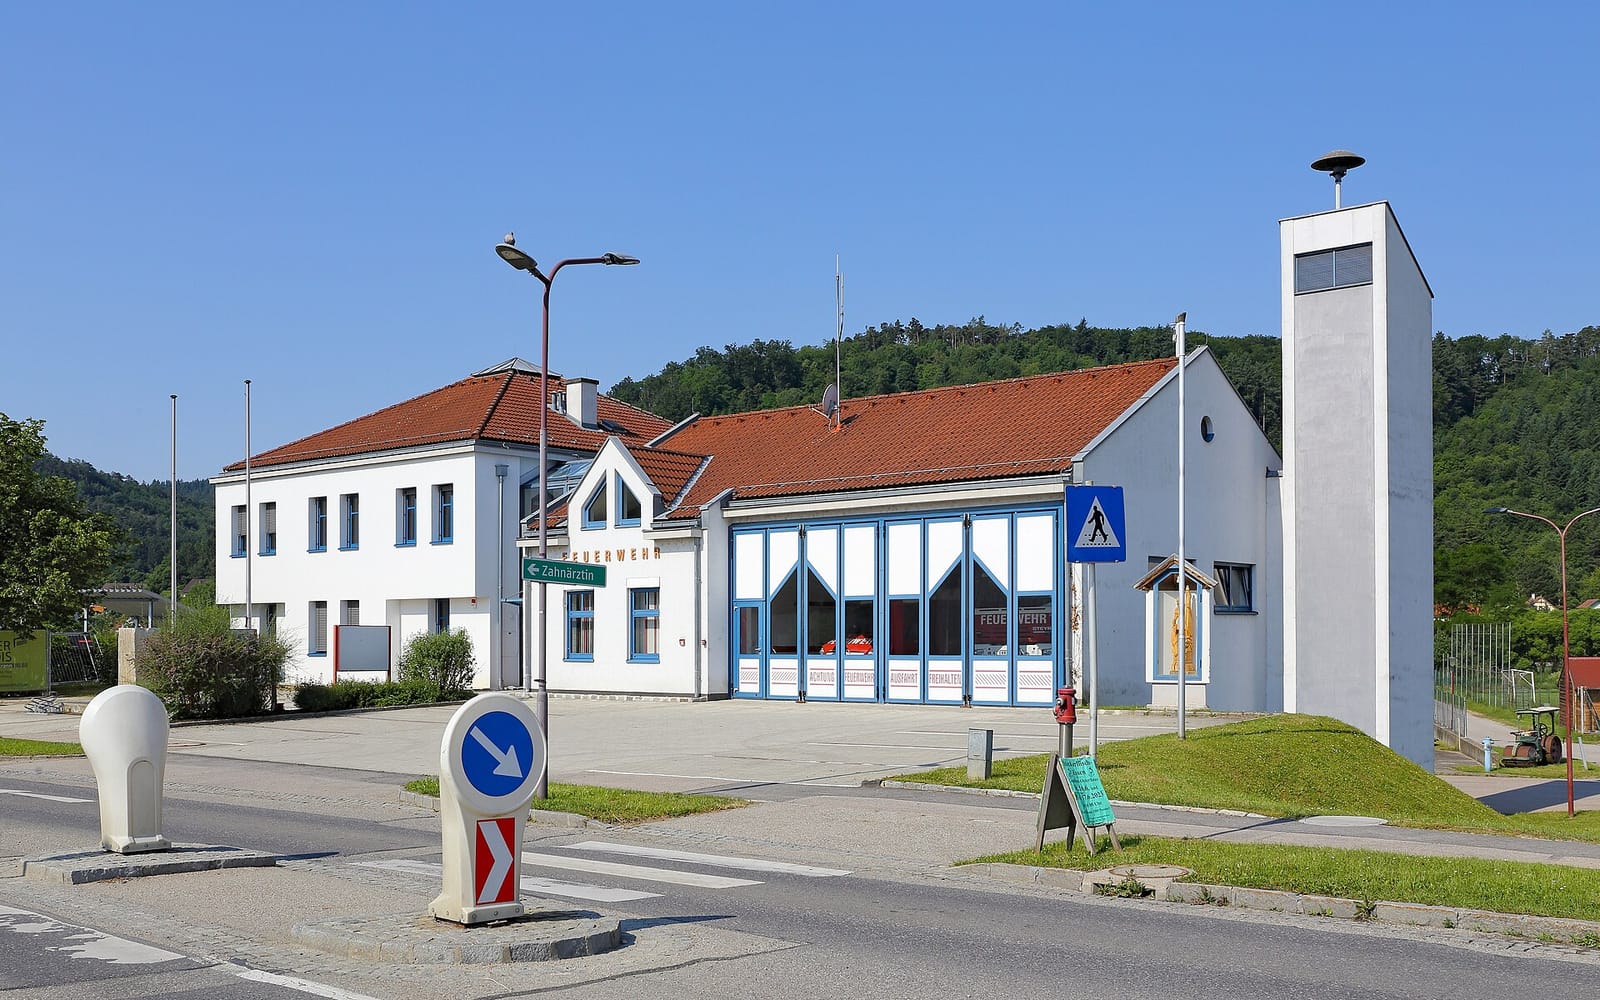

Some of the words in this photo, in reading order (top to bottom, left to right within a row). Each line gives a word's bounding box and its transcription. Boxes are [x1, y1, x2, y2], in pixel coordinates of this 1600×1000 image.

[561, 547, 661, 562] FEUERWEHR
[541, 565, 594, 581] Zahnärztin
[809, 671, 835, 682] ACHTUNG
[844, 671, 875, 683] FEUERWEHR
[890, 672, 918, 684] AUSFAHRT
[929, 673, 962, 685] FREIHALTEN
